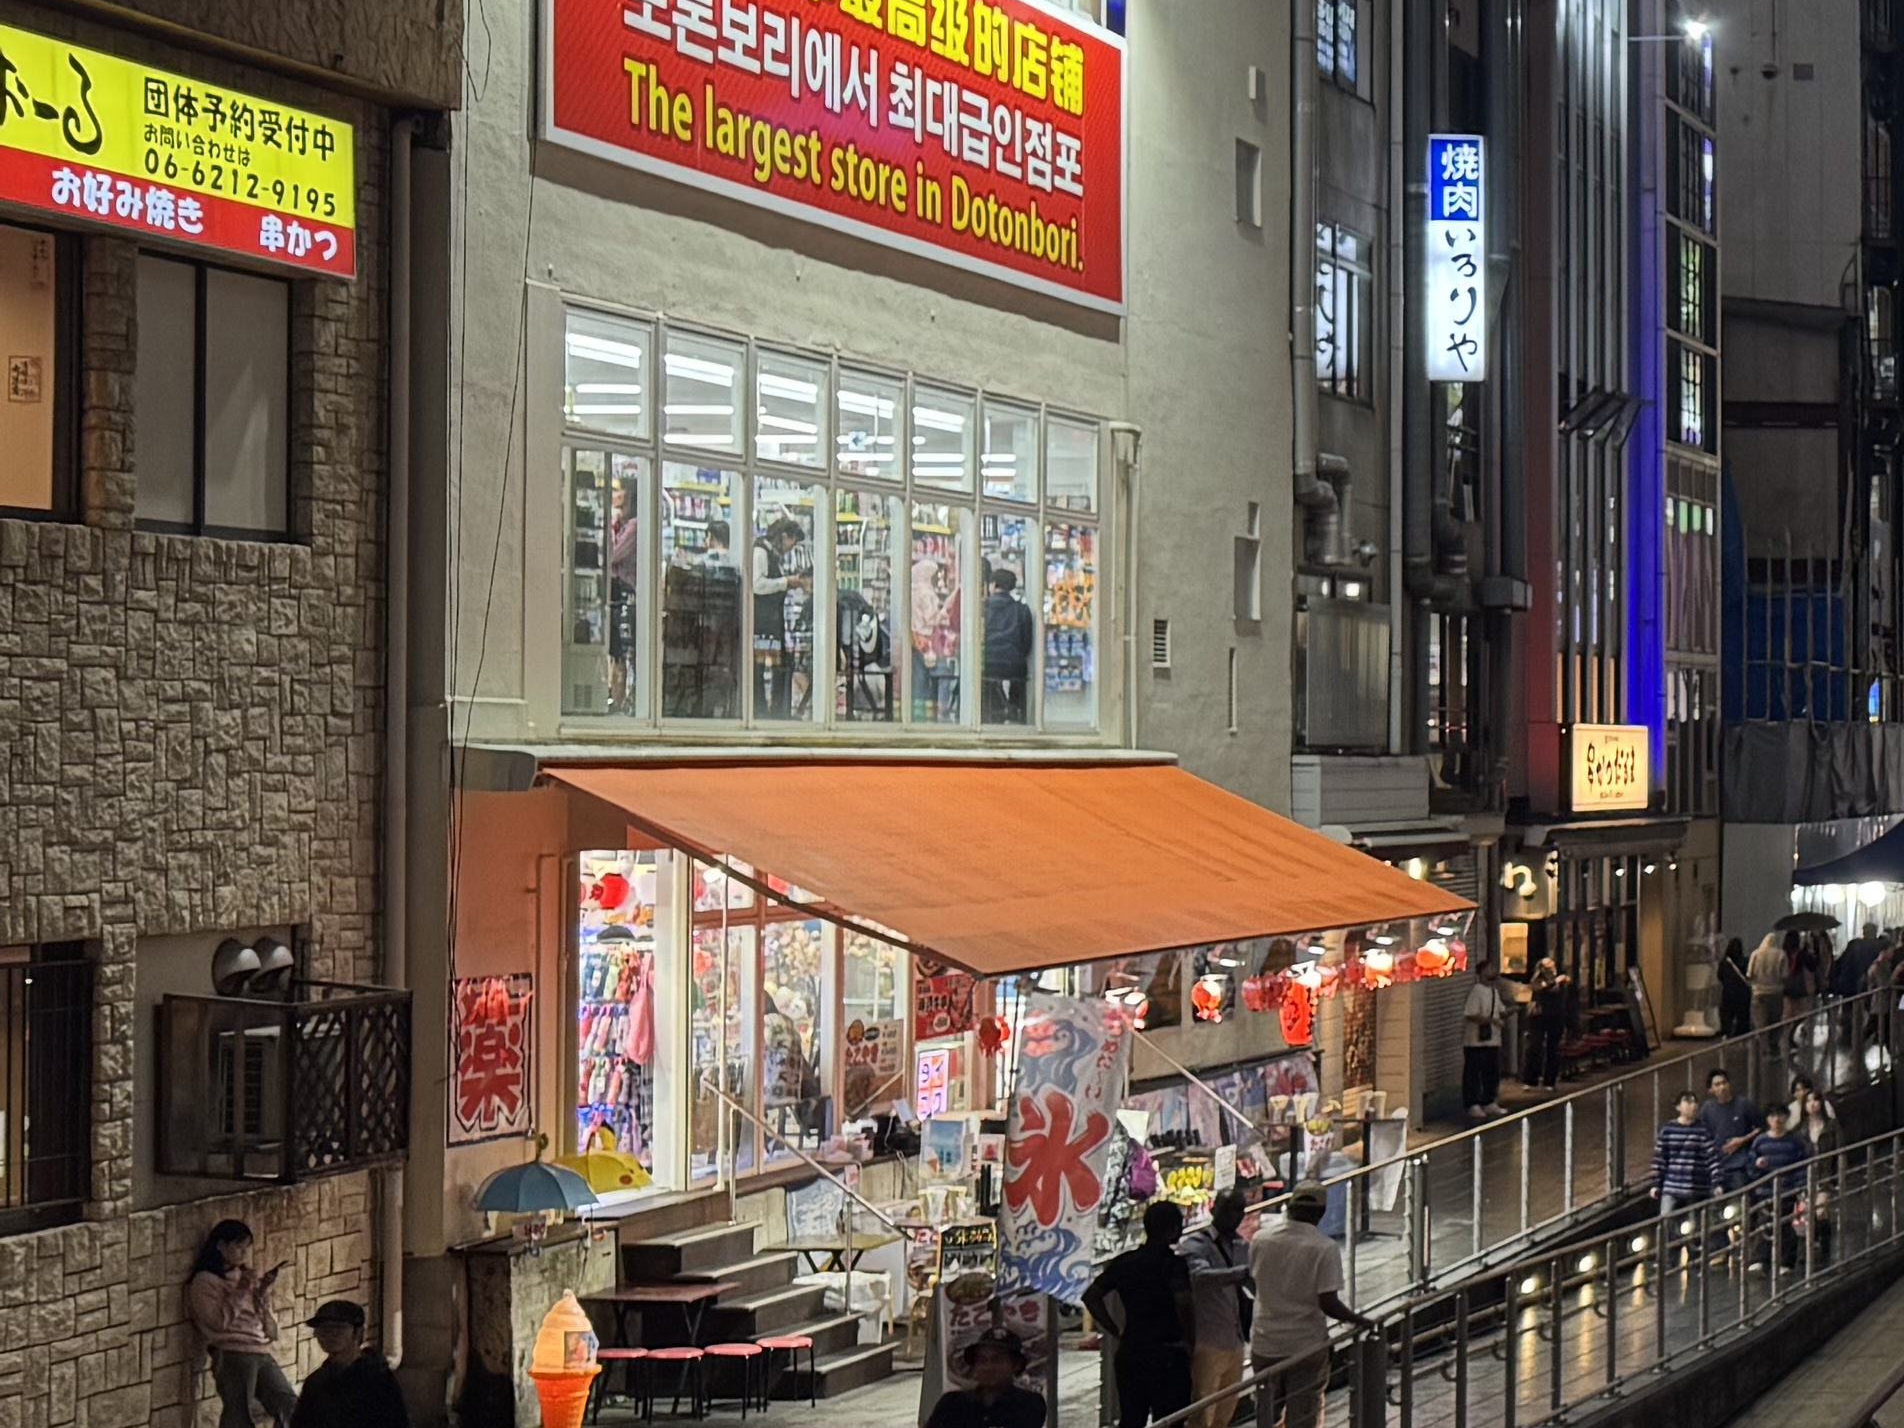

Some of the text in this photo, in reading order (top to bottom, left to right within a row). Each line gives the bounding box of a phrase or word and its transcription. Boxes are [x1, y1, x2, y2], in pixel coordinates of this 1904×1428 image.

[144, 76, 335, 162] 団体予約受付中
[144, 123, 251, 167] お問い合わせは
[624, 59, 1085, 272] The largest store in Dotonbori.
[888, 59, 1084, 198] 최대급인점포
[51, 166, 338, 261] お好み焼き 串かつ
[144, 148, 336, 217] 06-6212-9195
[1440, 141, 1479, 219] 焼肉
[1445, 229, 1478, 372] いろりや
[1003, 1090, 1110, 1228] 氷
